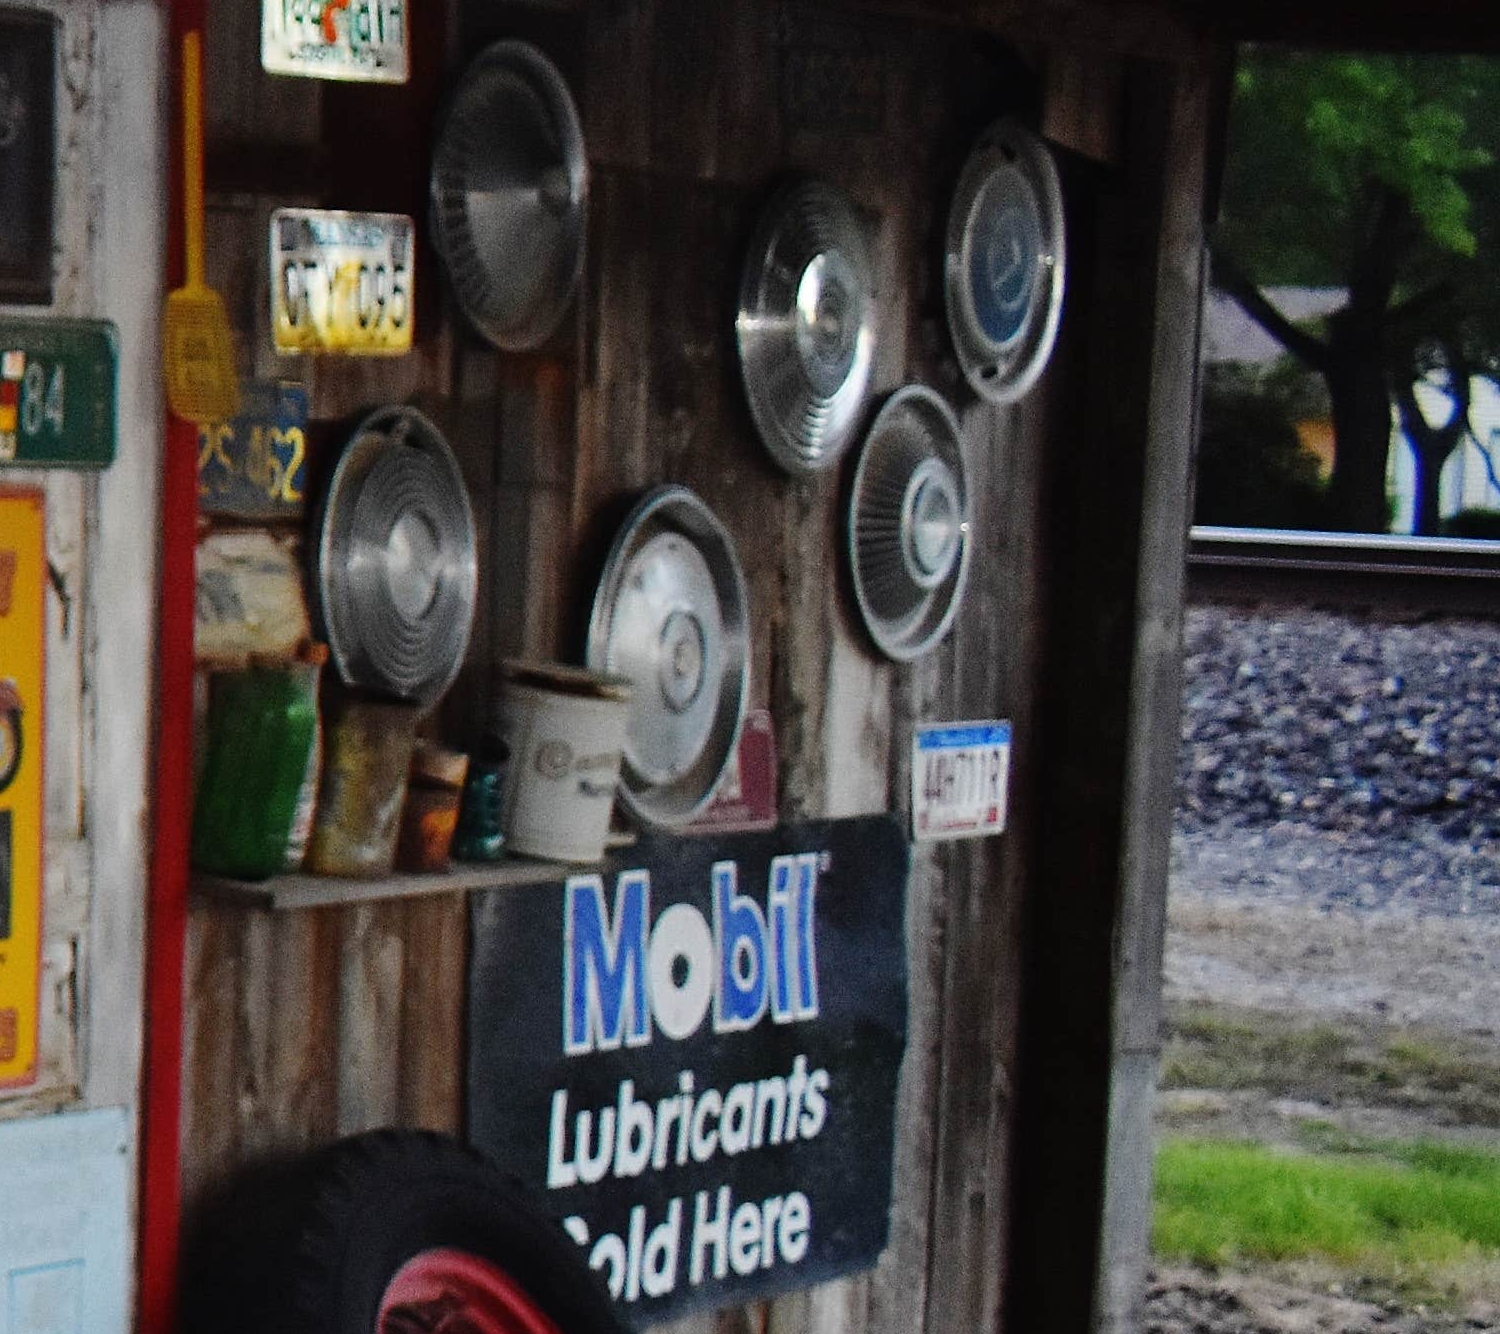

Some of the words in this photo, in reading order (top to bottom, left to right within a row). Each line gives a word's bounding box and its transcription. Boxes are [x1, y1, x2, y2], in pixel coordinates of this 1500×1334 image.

[564, 852, 818, 1056] Mobil
[547, 1054, 829, 1189] Lubricants
[690, 1185, 812, 1287] Here
